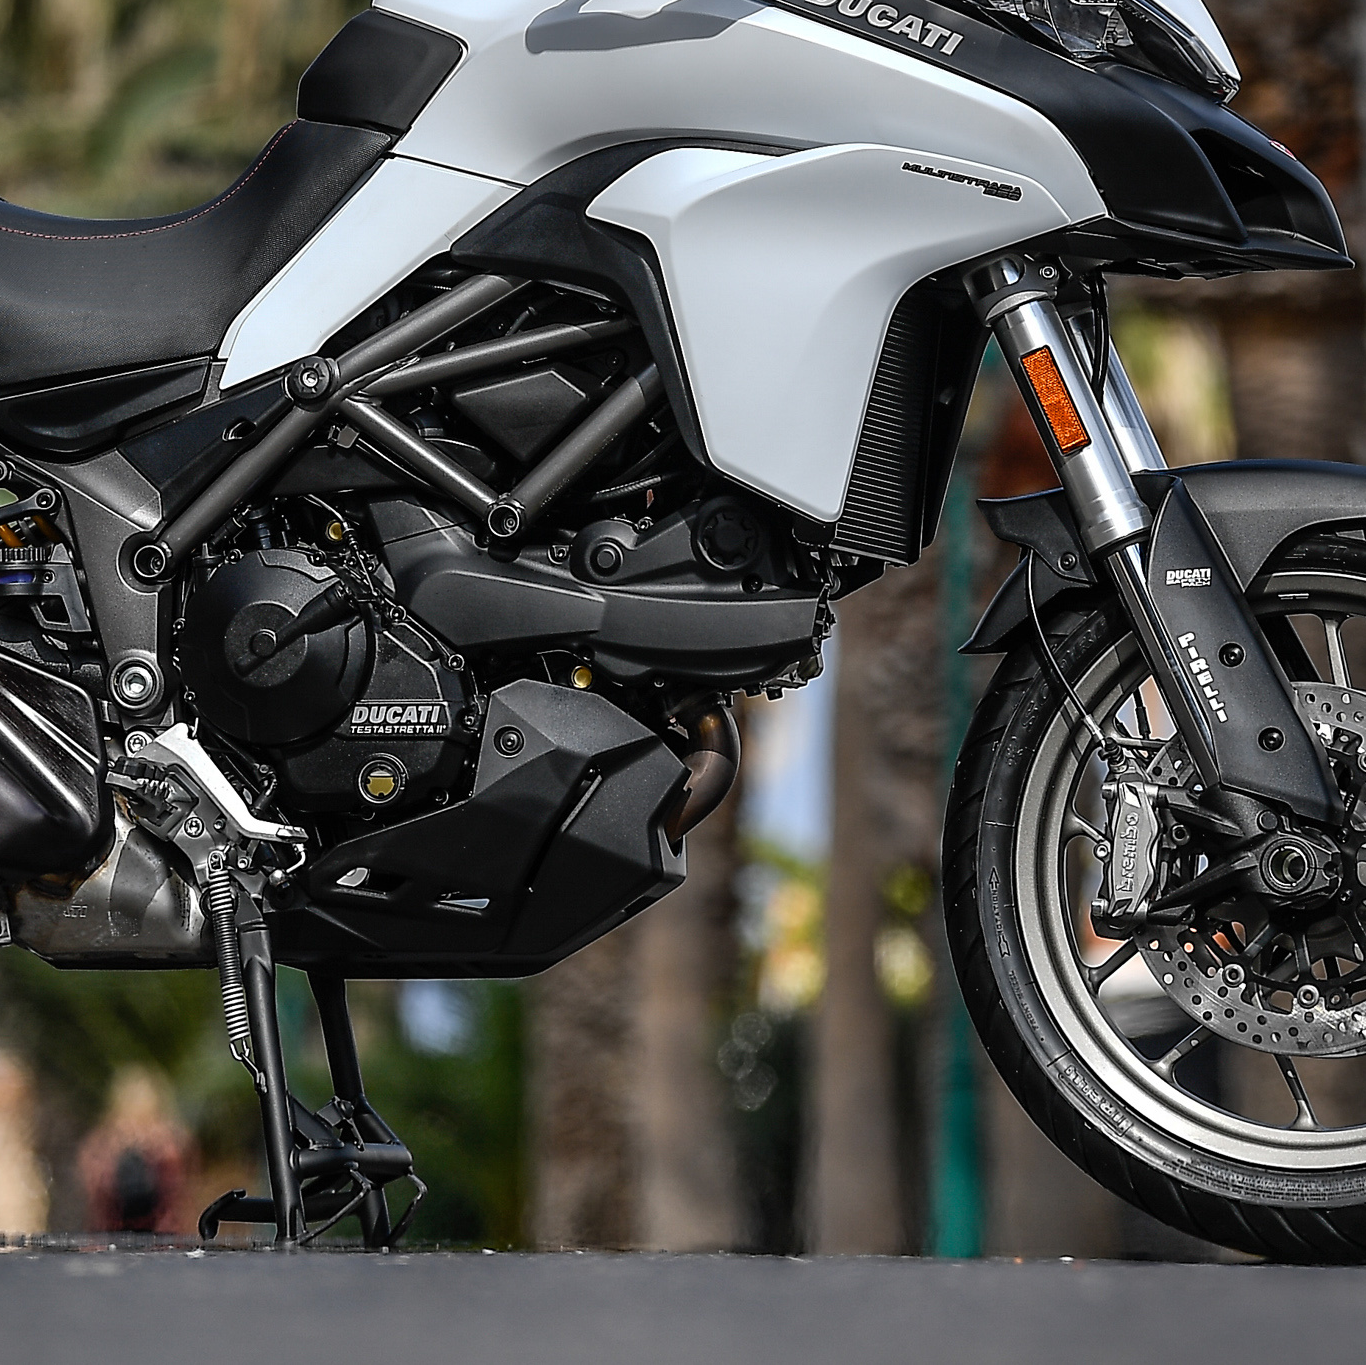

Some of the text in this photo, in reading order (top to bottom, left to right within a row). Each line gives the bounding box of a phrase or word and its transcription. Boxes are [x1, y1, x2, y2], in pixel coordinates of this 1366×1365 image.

[1166, 568, 1211, 580] DUCATI
[1177, 632, 1228, 723] PIRELLI
[351, 705, 441, 724] DUCATI
[350, 724, 434, 734] TESTASTRETTA
[1115, 811, 1140, 893] brembo
